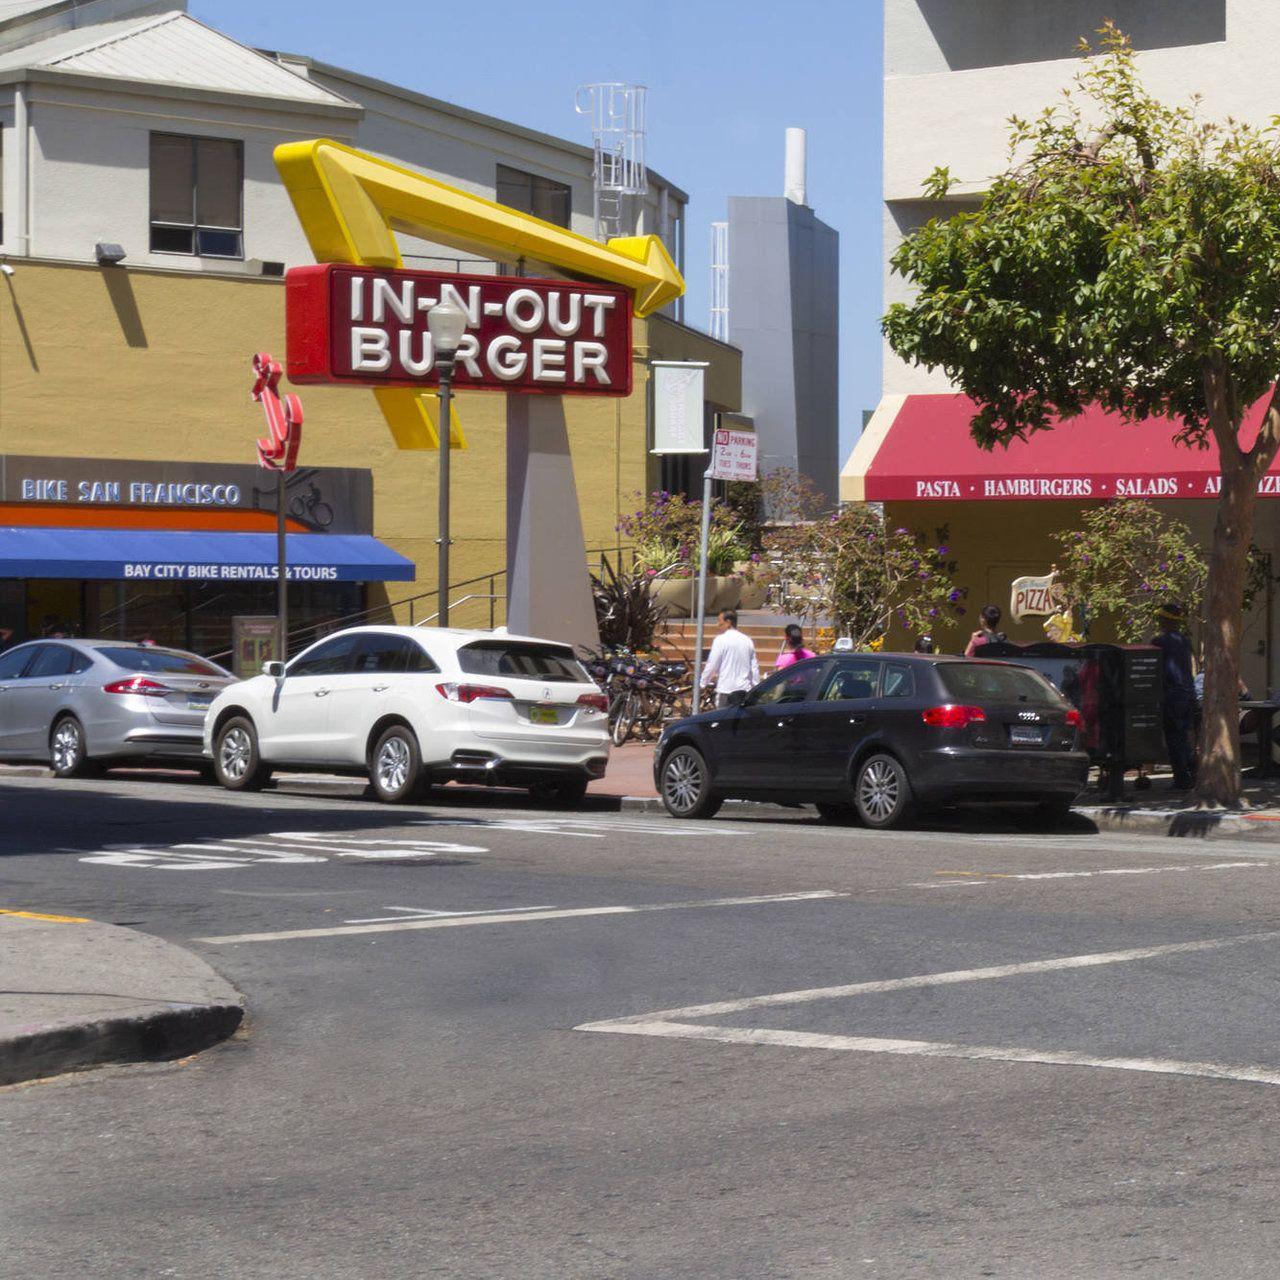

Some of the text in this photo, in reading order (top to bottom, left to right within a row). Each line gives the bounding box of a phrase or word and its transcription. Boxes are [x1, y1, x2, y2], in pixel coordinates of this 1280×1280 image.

[351, 277, 616, 338] IN-N-OUT
[351, 327, 611, 384] BURGER
[22, 479, 241, 505] BIKE SAN FRANCISCO
[916, 480, 961, 497] PASTA
[983, 478, 1092, 496] HAMBURGERS
[1115, 477, 1178, 496] SALADS
[125, 564, 151, 578] BAY
[154, 565, 186, 578] CITY
[188, 565, 220, 579] BIKE
[221, 566, 280, 579] RENTALS
[294, 566, 337, 580] TOURS
[1016, 588, 1054, 615] PIZZA
